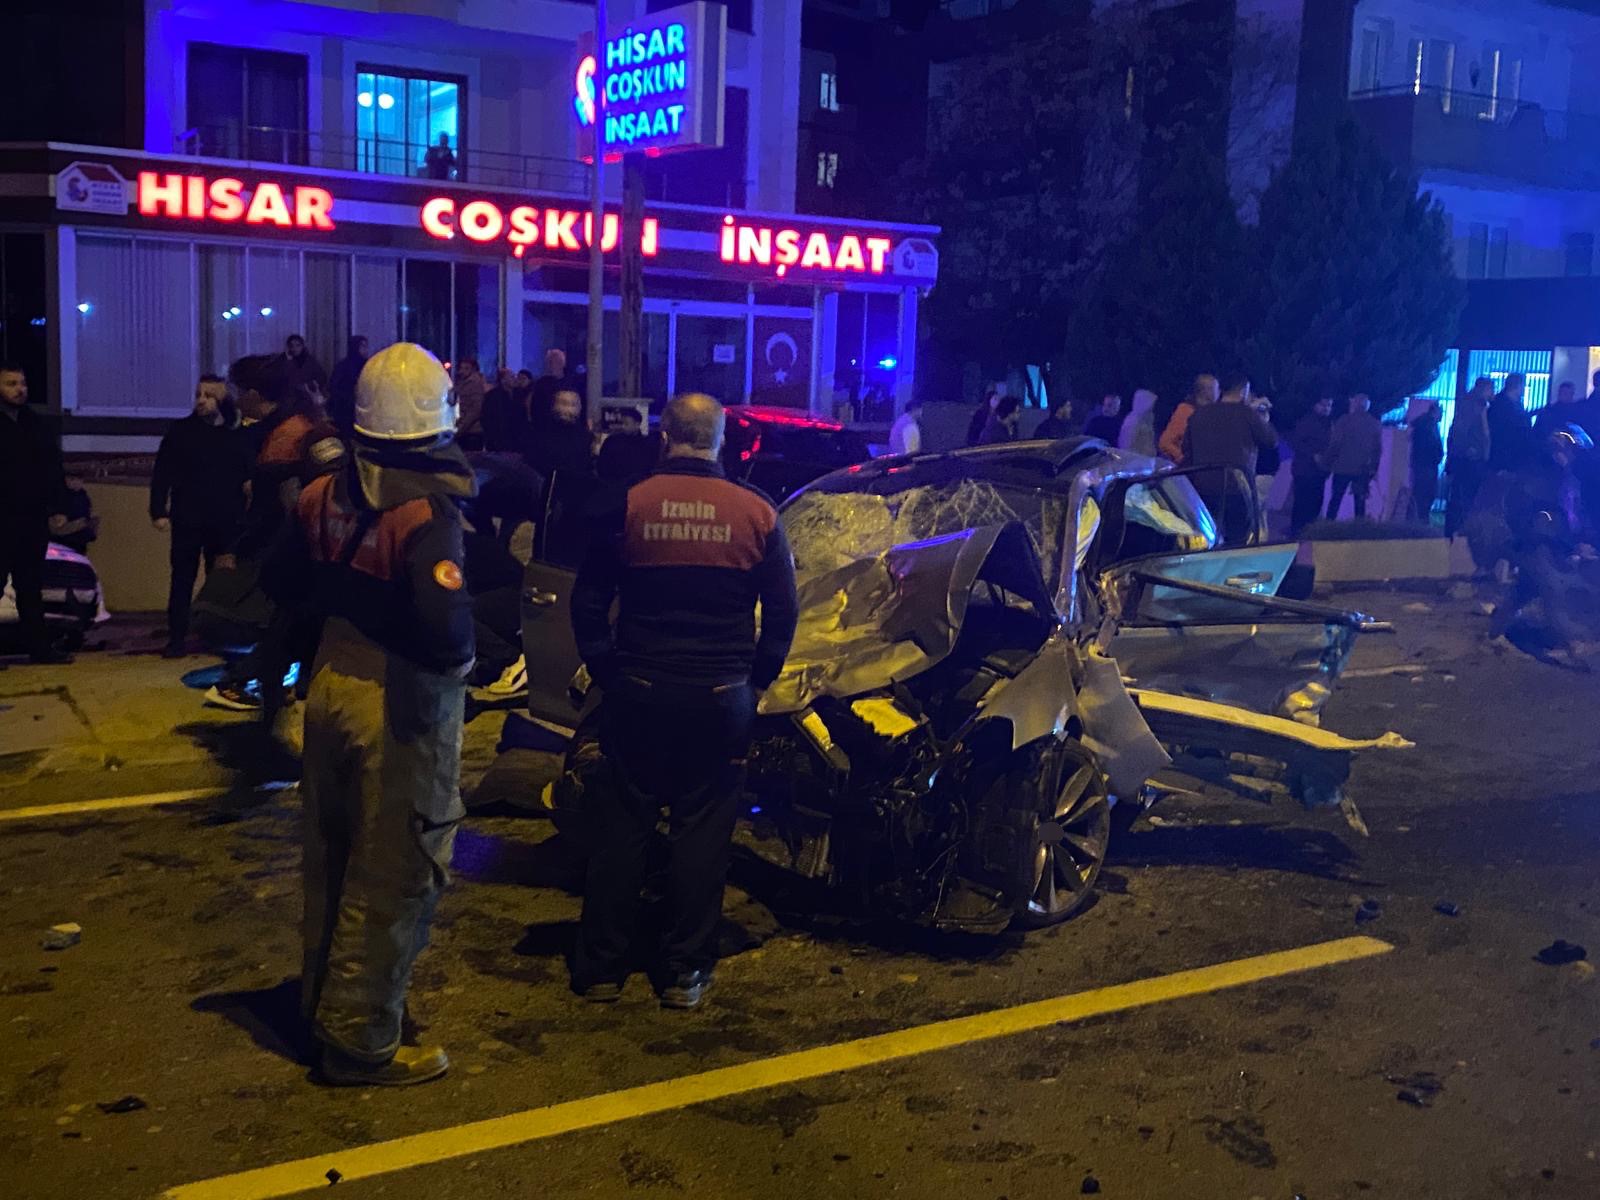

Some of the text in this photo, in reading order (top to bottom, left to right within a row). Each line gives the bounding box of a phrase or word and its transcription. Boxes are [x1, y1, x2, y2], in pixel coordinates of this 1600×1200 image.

[606, 24, 685, 69] HİSAR
[606, 60, 685, 104] COŞKUN
[605, 105, 684, 145] İNŞAAT
[138, 171, 336, 230] HISAR
[720, 215, 891, 277] İNŞAAT
